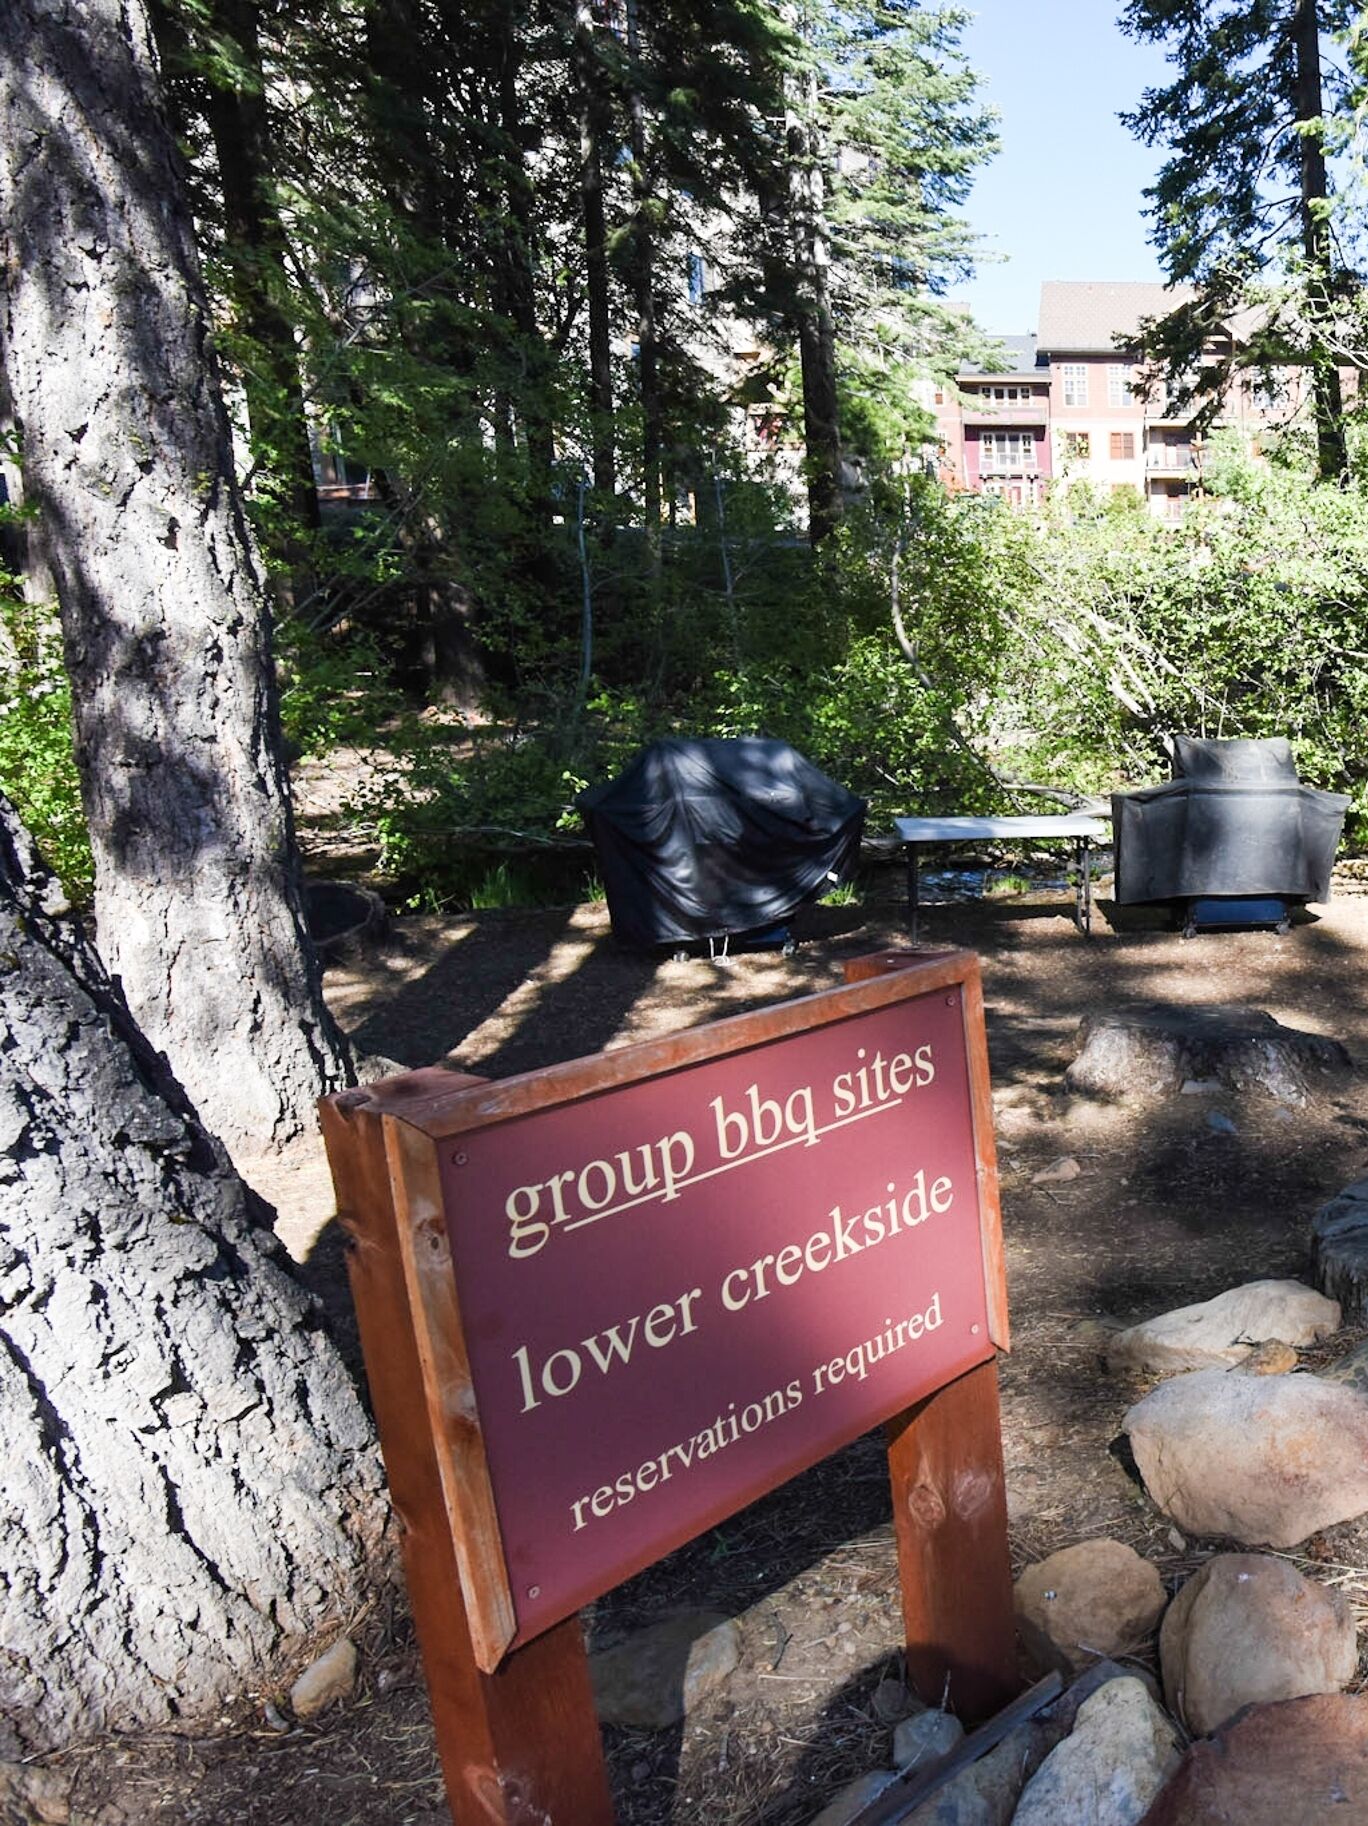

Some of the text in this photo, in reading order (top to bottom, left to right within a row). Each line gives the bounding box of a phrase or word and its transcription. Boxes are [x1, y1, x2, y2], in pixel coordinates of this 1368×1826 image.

[505, 1044, 935, 1258] group bbq sites
[512, 1169, 954, 1413] lower creekside
[570, 1294, 943, 1531] reservations required
